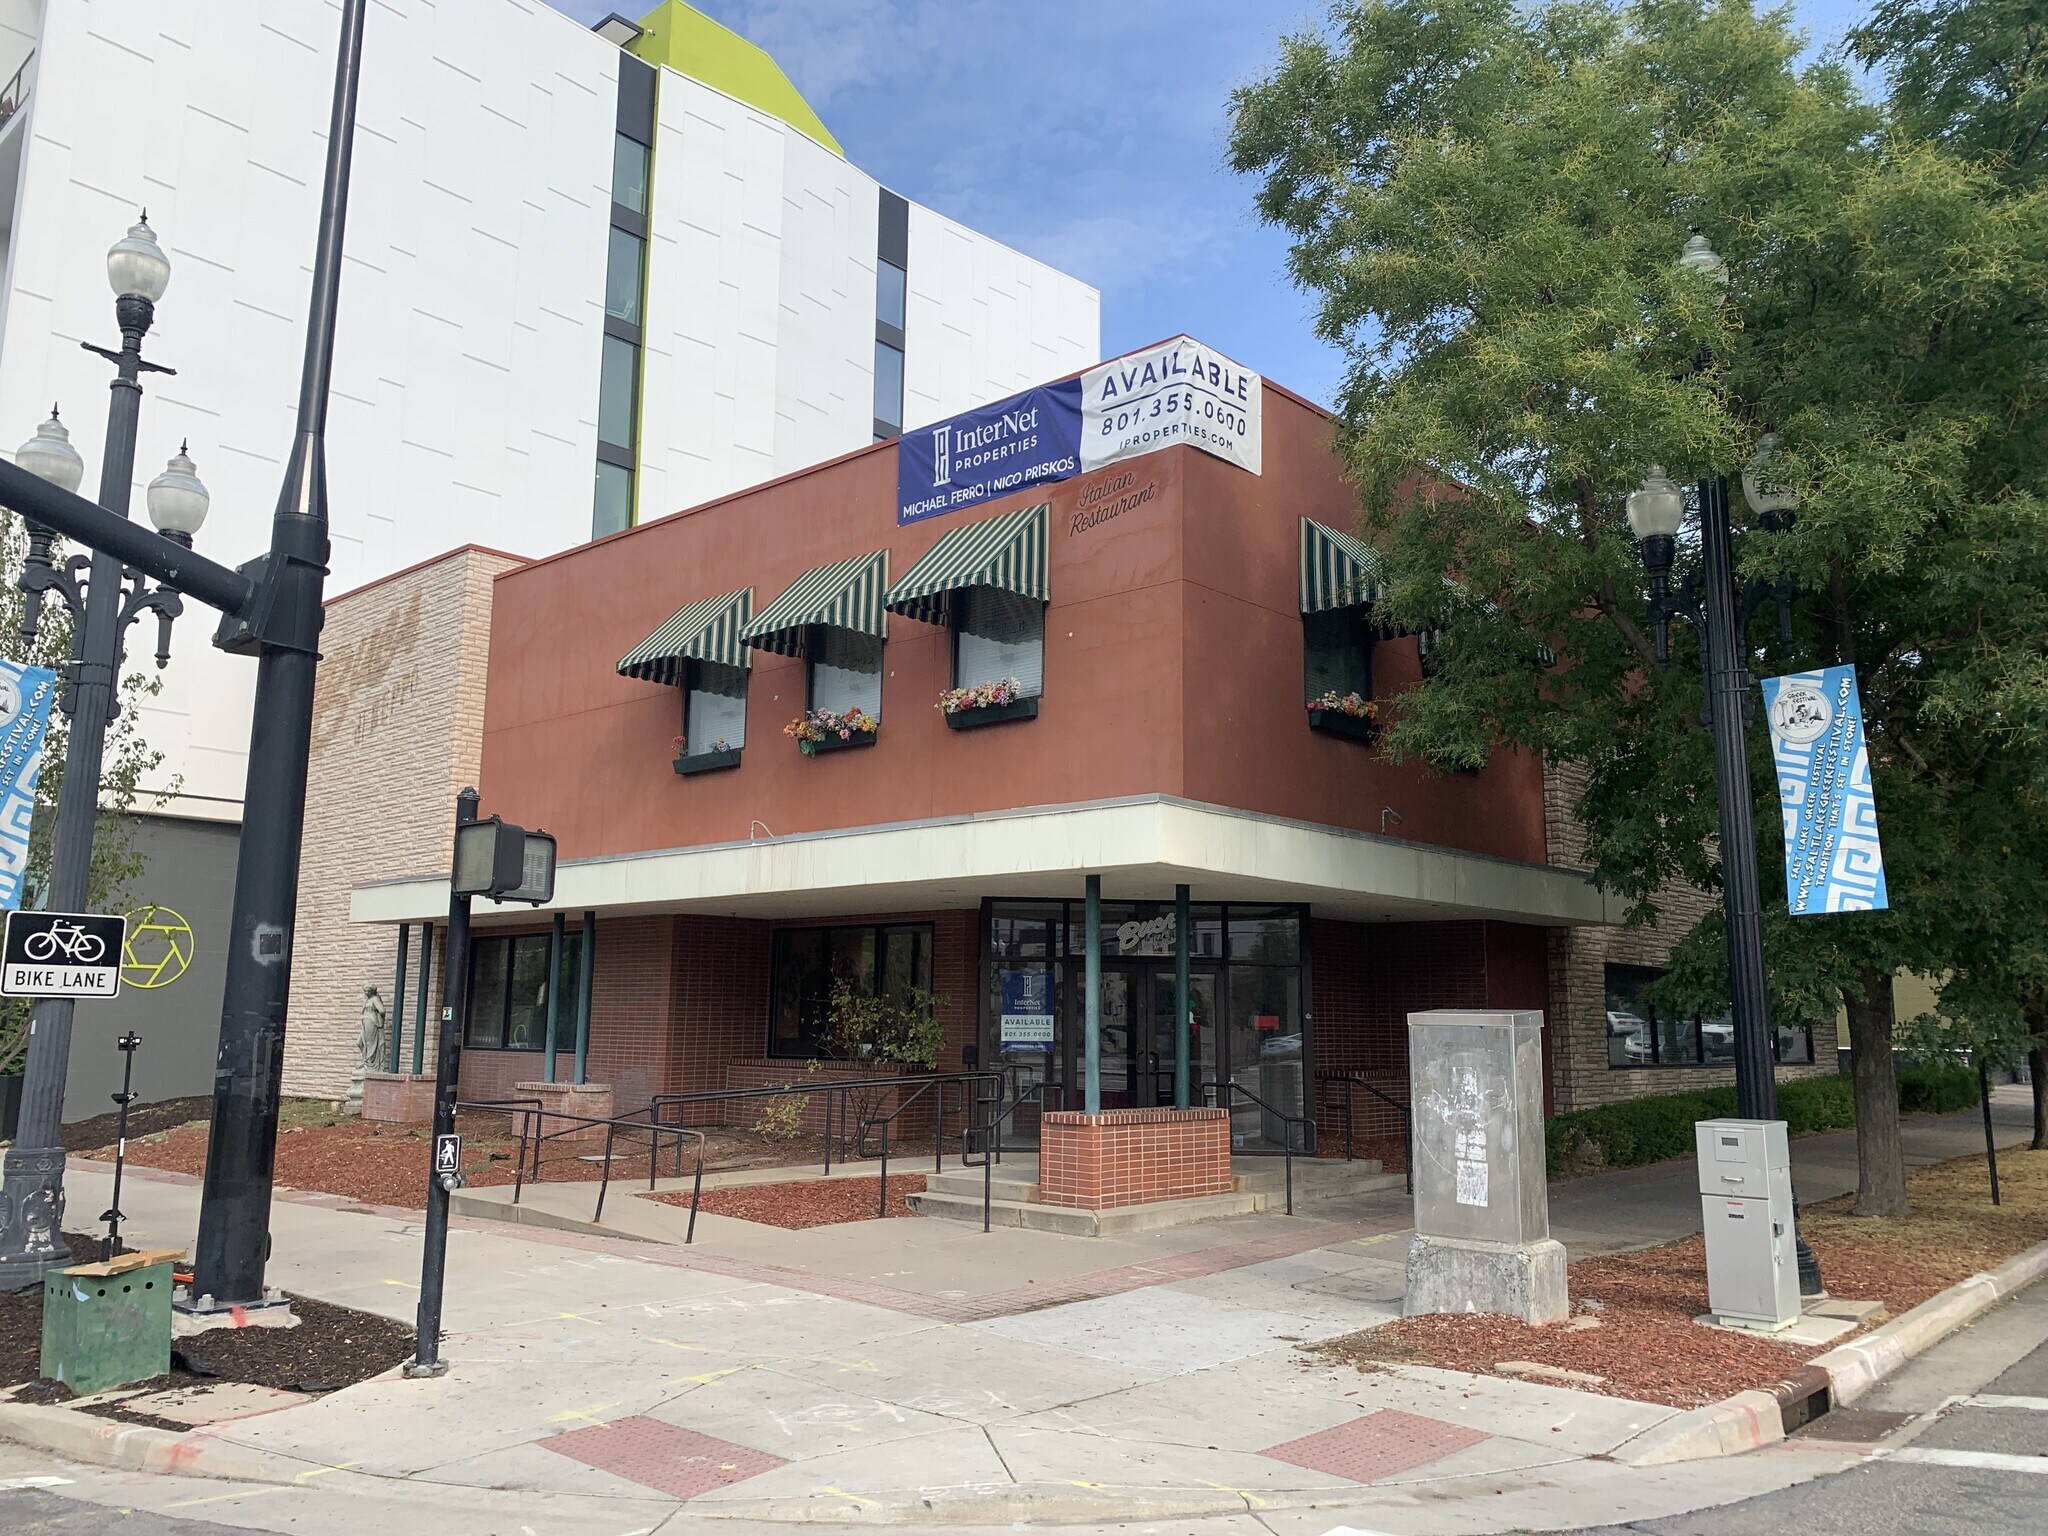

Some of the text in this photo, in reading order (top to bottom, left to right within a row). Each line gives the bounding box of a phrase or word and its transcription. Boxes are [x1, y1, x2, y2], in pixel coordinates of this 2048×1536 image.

[1100, 352, 1248, 402] AVAILABLE
[955, 406, 1039, 454] InterNet
[1101, 392, 1246, 436] 801.355.0600
[1119, 422, 1233, 450] IPROPERTIES.COM
[955, 434, 1038, 472] PROPERTIES
[903, 495, 948, 518] MICHAEL
[951, 483, 984, 504] FERRO
[993, 471, 1022, 491] NICO
[1024, 455, 1075, 482] PRISKOS
[1070, 482, 1155, 537] Restaurant
[1079, 472, 1134, 507] Italian
[2, 718, 43, 786] SET IN STONE!
[1790, 742, 1826, 880] SALT LAKE GREEK FESTIVAL
[1794, 677, 1852, 912] WWW.SALTLAKEGREEKFESTIVAL.COM
[1815, 715, 1857, 887] TRADITION THAT'S SET IN STONE!
[15, 970, 106, 988] BIKE LANE
[1004, 1018, 1051, 1026] AVAILABLE
